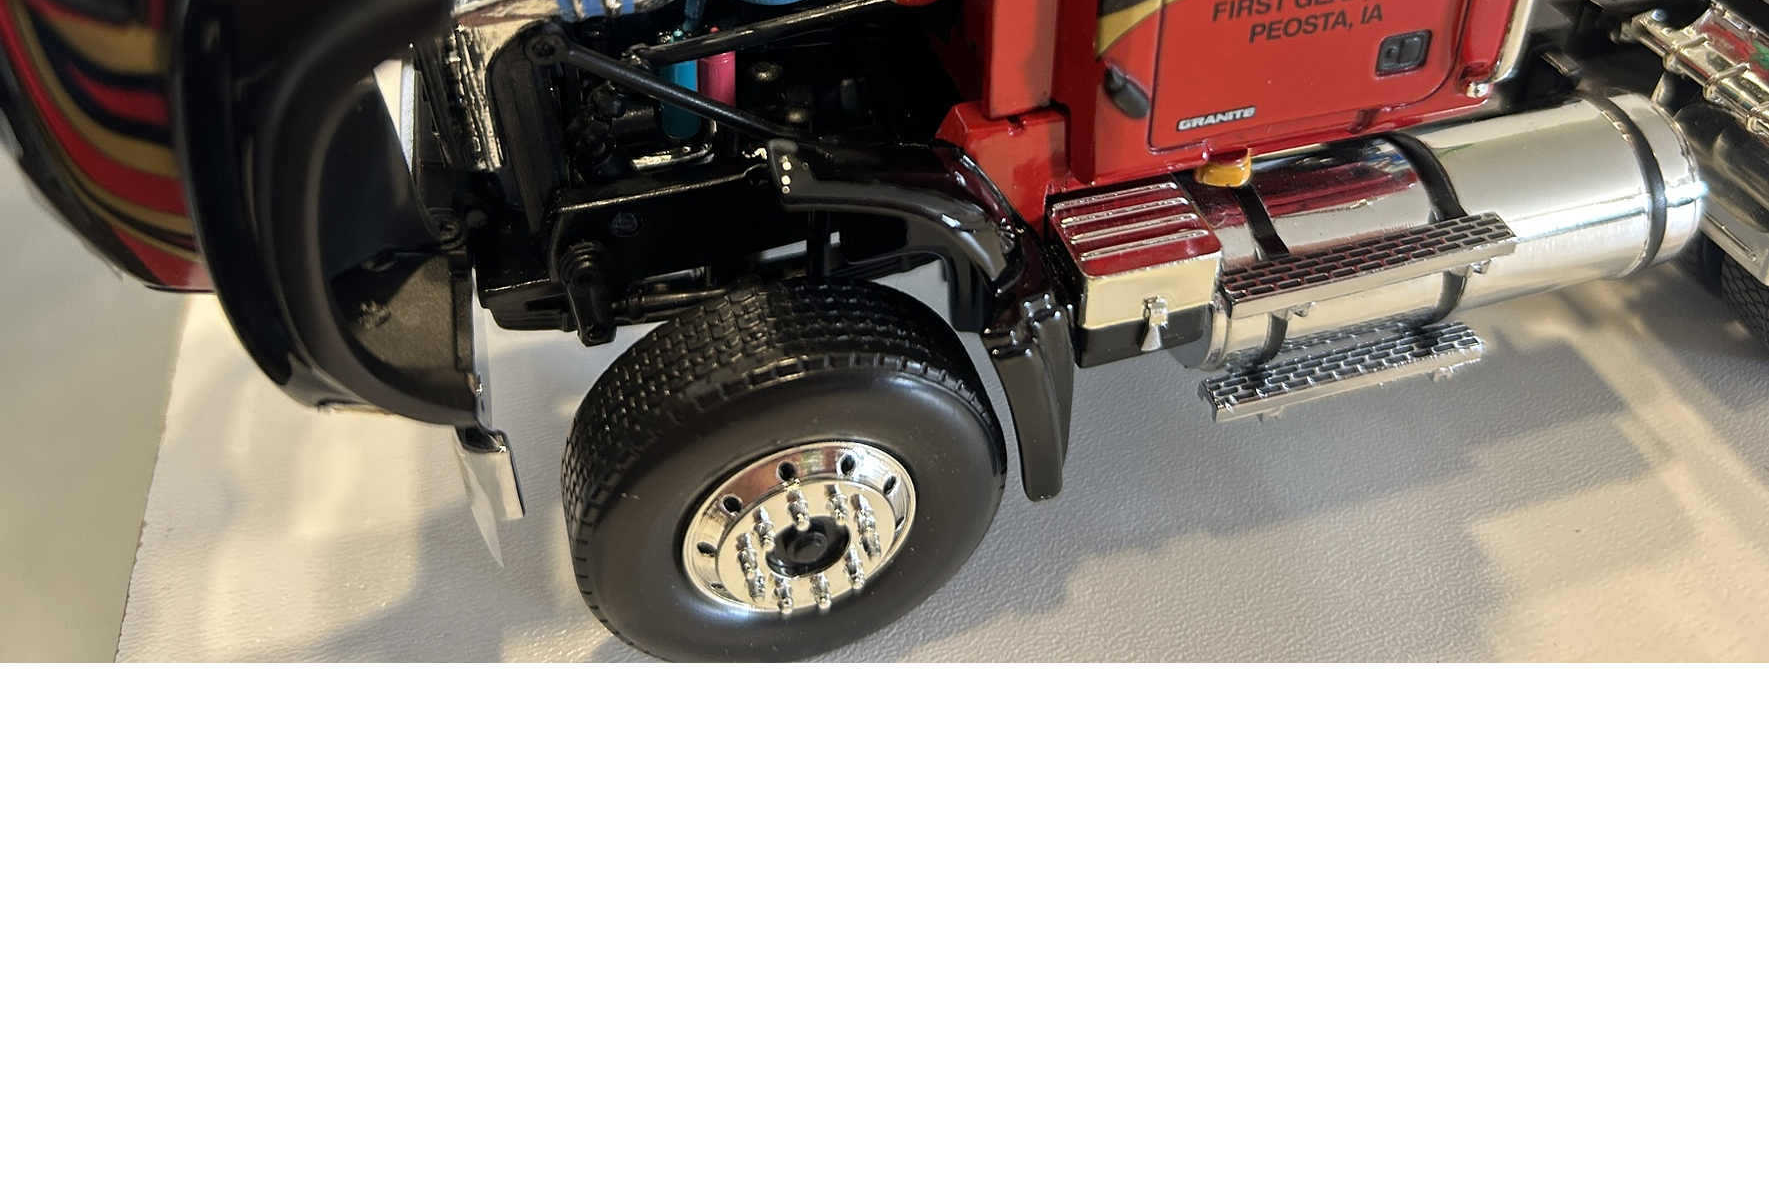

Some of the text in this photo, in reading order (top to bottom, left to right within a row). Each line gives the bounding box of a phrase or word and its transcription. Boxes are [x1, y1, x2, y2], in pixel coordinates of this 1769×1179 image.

[1249, 4, 1383, 43] PEOSTA, IA
[1177, 106, 1255, 131] GRANITE
